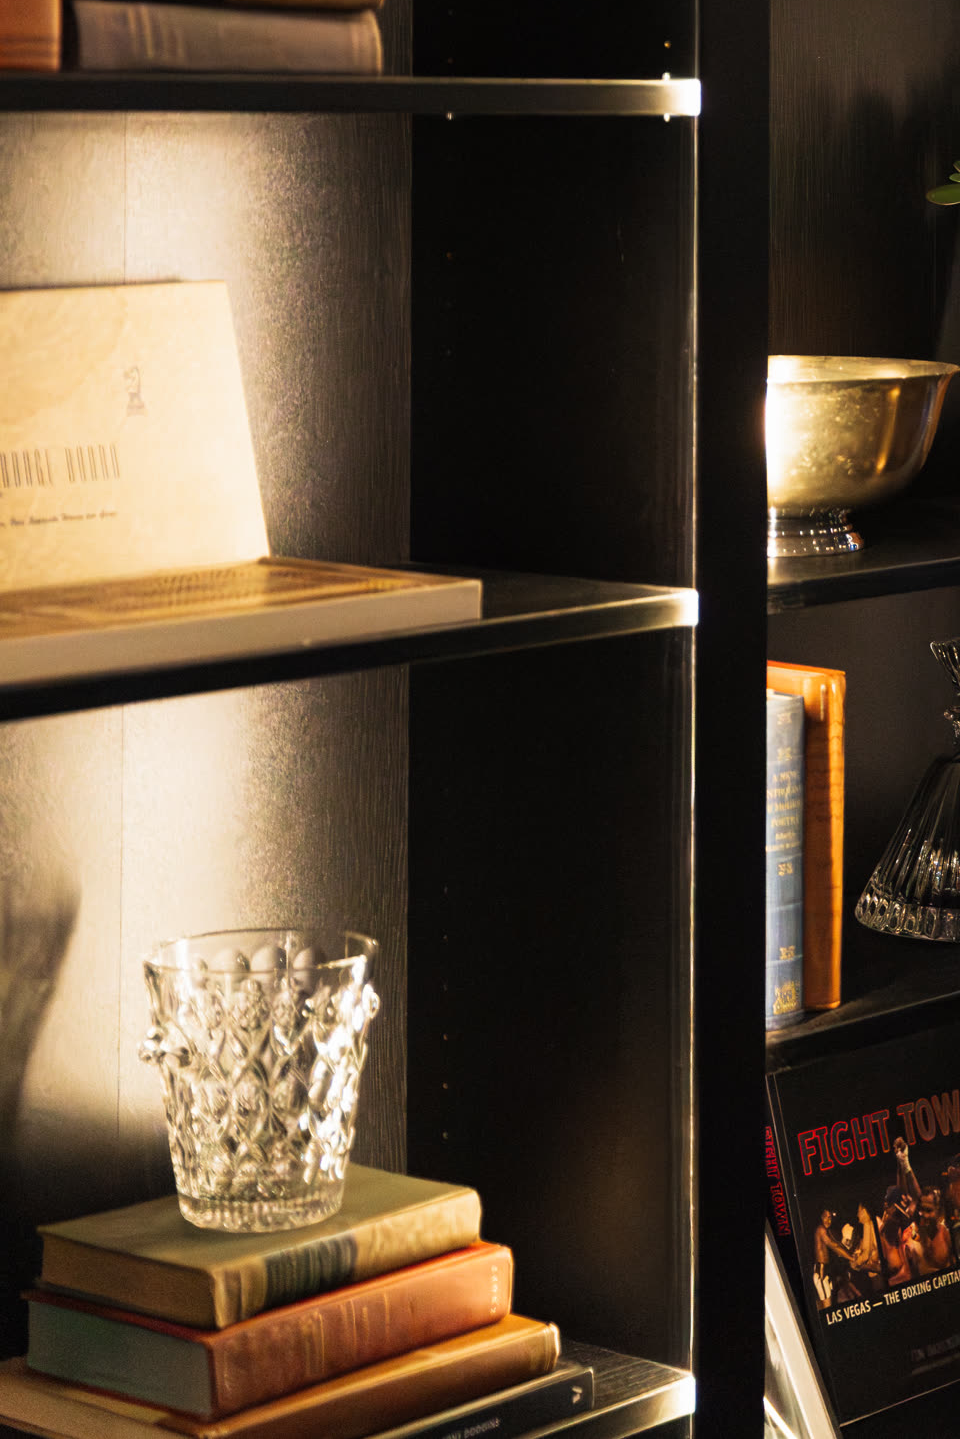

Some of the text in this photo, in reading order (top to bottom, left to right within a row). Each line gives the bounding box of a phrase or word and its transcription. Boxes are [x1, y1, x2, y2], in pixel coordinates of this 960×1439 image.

[797, 1109, 890, 1176] FIGHT
[826, 1309, 843, 1326] LAS
[844, 1299, 872, 1320] VEGAS
[884, 1290, 901, 1306] THE
[901, 1279, 932, 1301] BOXING
